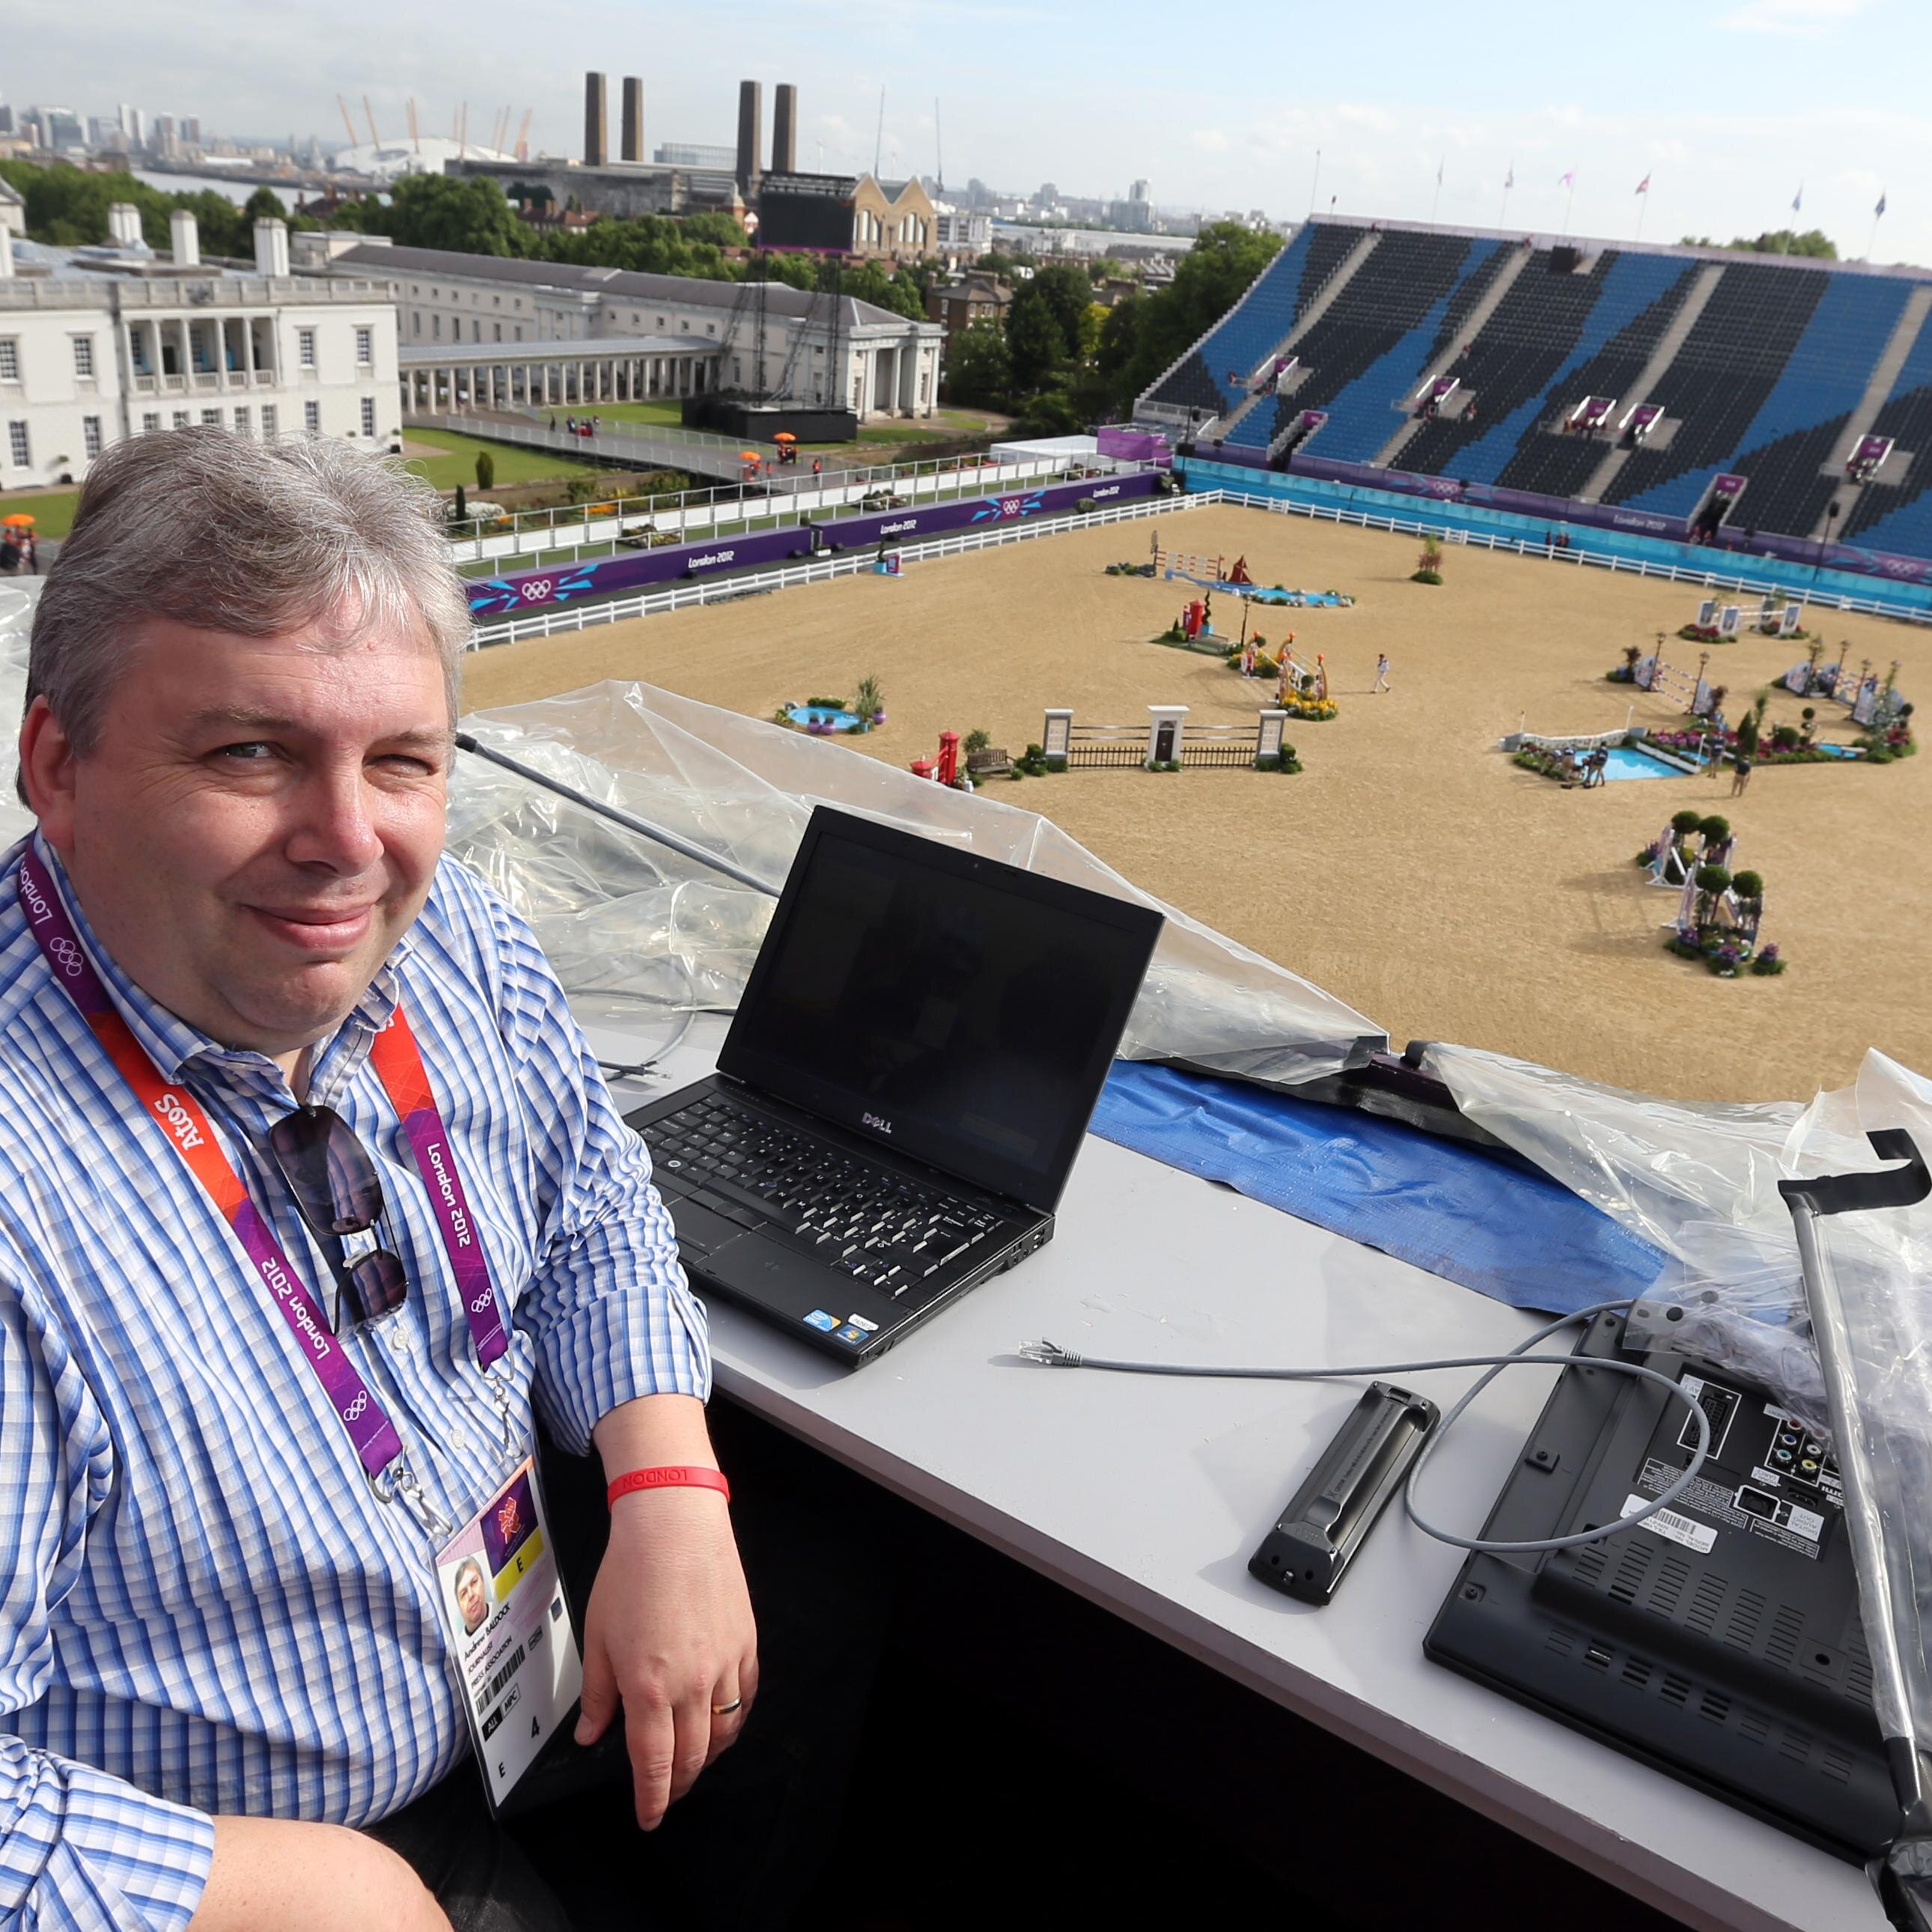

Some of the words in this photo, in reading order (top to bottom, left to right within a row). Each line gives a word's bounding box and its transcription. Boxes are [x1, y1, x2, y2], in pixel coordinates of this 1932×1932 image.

[880, 522, 903, 534] London
[903, 519, 917, 530] 2012
[688, 554, 716, 569] London
[716, 550, 735, 563] 2012
[154, 1094, 204, 1151] Atos
[862, 1112, 892, 1133] DELL
[427, 1142, 456, 1207] London
[451, 1207, 471, 1248] 2012
[261, 1257, 293, 1299] 2012
[289, 1296, 330, 1359] London
[622, 1469, 687, 1489] LONDON
[516, 1559, 523, 1573] E
[531, 1715, 540, 1738] 4
[499, 1761, 506, 1779] E
